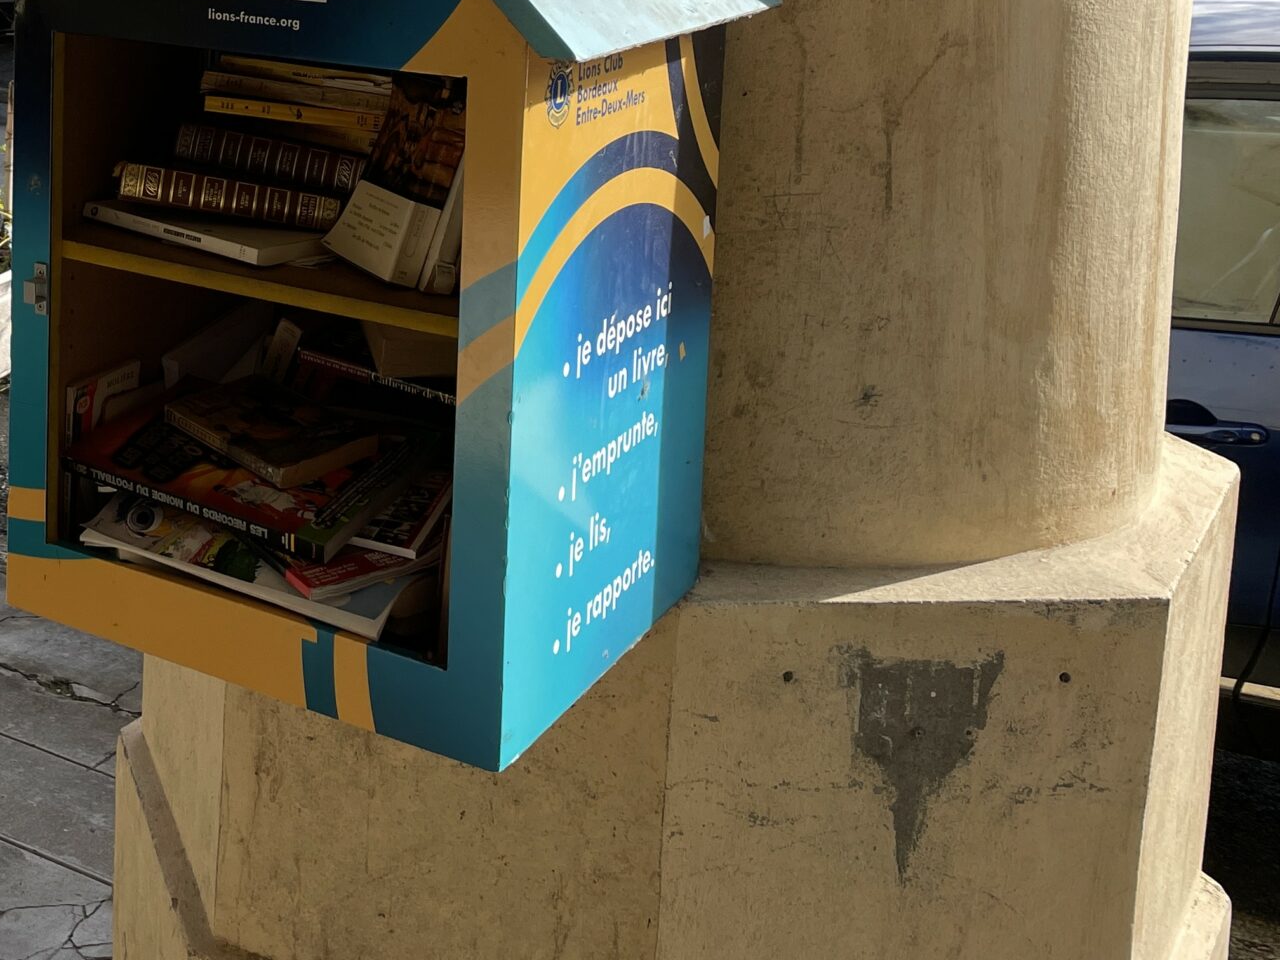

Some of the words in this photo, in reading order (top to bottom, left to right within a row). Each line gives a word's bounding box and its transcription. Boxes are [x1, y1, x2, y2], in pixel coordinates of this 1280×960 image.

[207, 8, 301, 31] lions-france.org
[578, 61, 601, 82] Lions
[604, 53, 624, 73] Club
[576, 77, 619, 104] Bordeaux
[575, 90, 646, 126] Entre-Deux-Mers
[576, 332, 592, 380] je
[596, 304, 651, 357] dépose
[656, 281, 673, 321] ici
[608, 366, 628, 398] un
[632, 343, 669, 384] livre,
[571, 410, 659, 502] j'emprunte,
[89, 468, 134, 492] FOOTBALL
[135, 484, 149, 497] DU
[152, 489, 184, 510] MONDE
[186, 501, 200, 515] DU
[202, 507, 247, 532] RECORDS
[250, 524, 268, 539] LES
[569, 531, 584, 577] je
[589, 512, 611, 552] lis,
[566, 607, 582, 653] je
[586, 549, 655, 625] rapporte.
